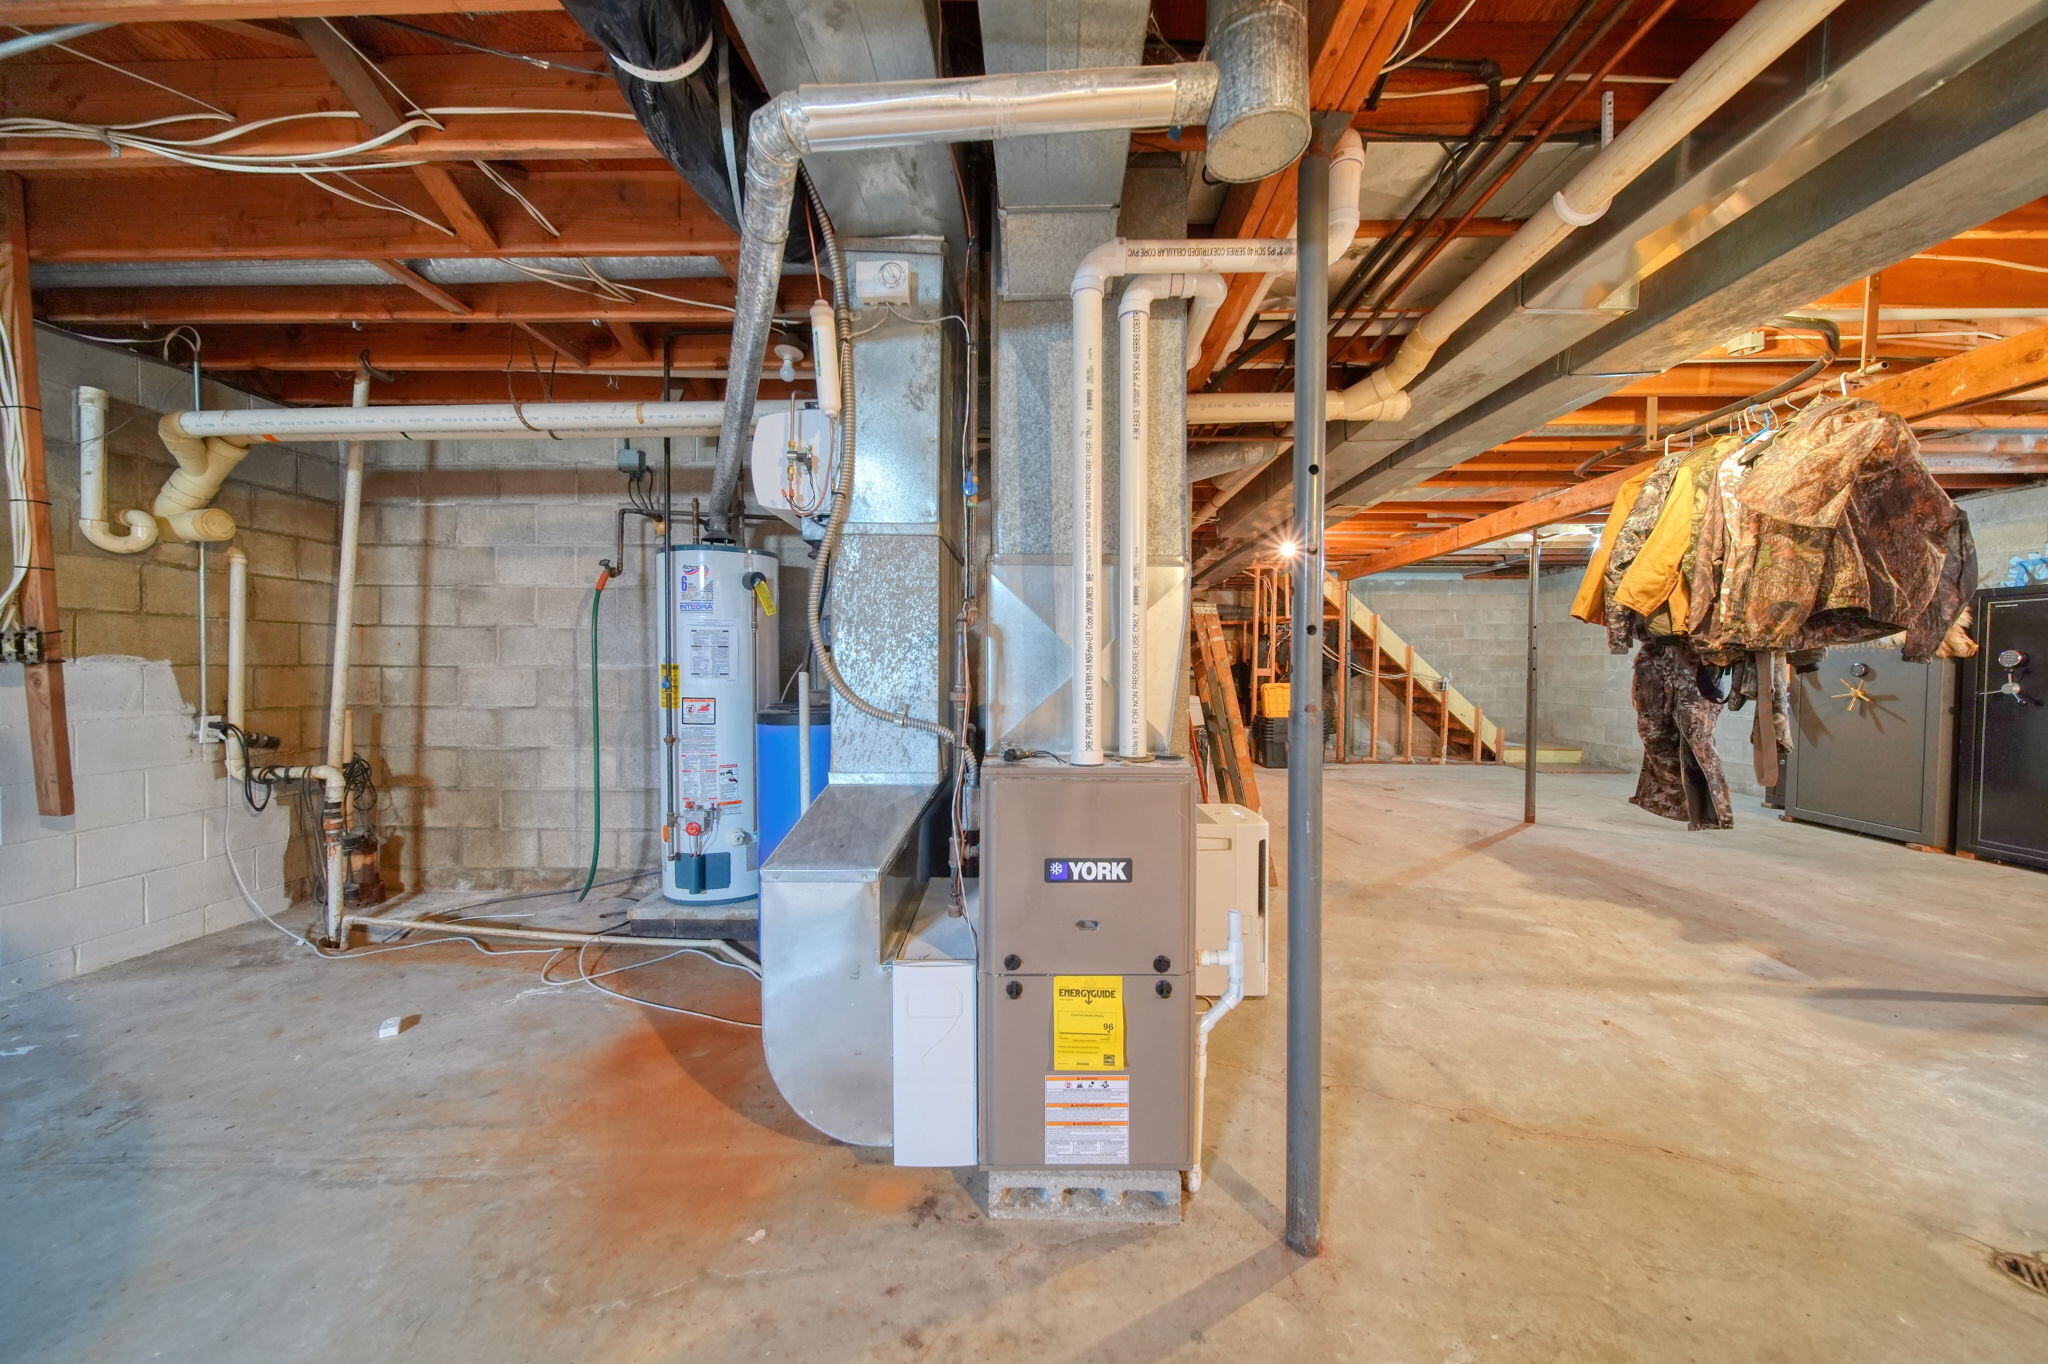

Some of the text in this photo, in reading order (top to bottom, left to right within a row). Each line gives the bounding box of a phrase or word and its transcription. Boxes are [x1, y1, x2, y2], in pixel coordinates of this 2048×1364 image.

[1128, 248, 1140, 258] PVC
[1140, 248, 1156, 257] CORE
[1158, 248, 1186, 256] CELLULAR
[1188, 248, 1225, 256] COEXTRUDED
[1226, 247, 1246, 256] SERIES
[1247, 247, 1254, 256] 40
[1254, 246, 1266, 256] SCH
[1267, 246, 1276, 256] IPS
[682, 575, 688, 592] 6
[1085, 616, 1093, 630] Code
[1132, 613, 1140, 632] ONLY
[1085, 686, 1093, 700] ASTM
[1085, 702, 1093, 714] PIPE
[1085, 728, 1093, 740] PVC
[1068, 862, 1127, 880] YORK
[1058, 988, 1116, 999] ENERGYGUIDE
[1103, 1023, 1114, 1031] 96
